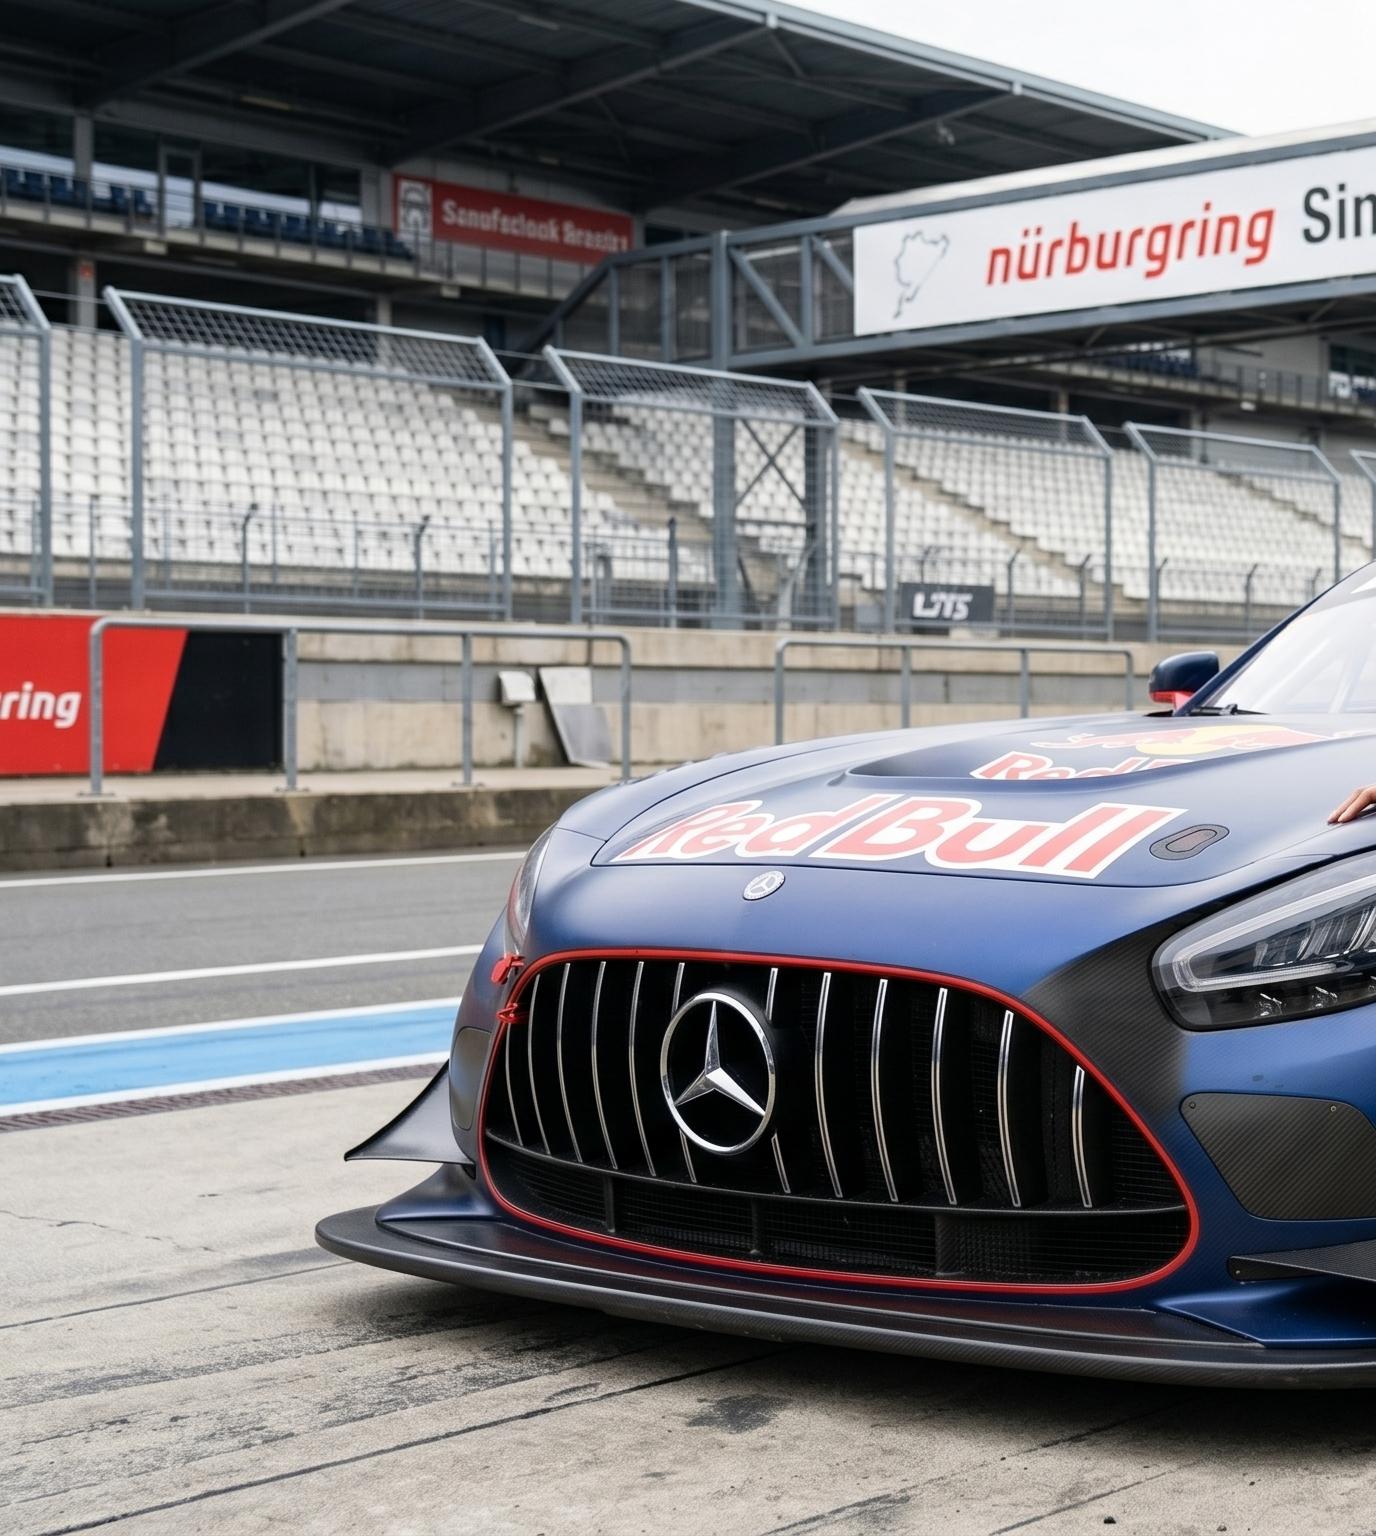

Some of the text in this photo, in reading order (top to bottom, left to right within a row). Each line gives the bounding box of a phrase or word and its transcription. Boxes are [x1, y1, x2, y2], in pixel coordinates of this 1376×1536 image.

[987, 202, 1275, 284] nürburgring
[0, 681, 82, 729] ring
[609, 793, 1189, 880] Red Bull
